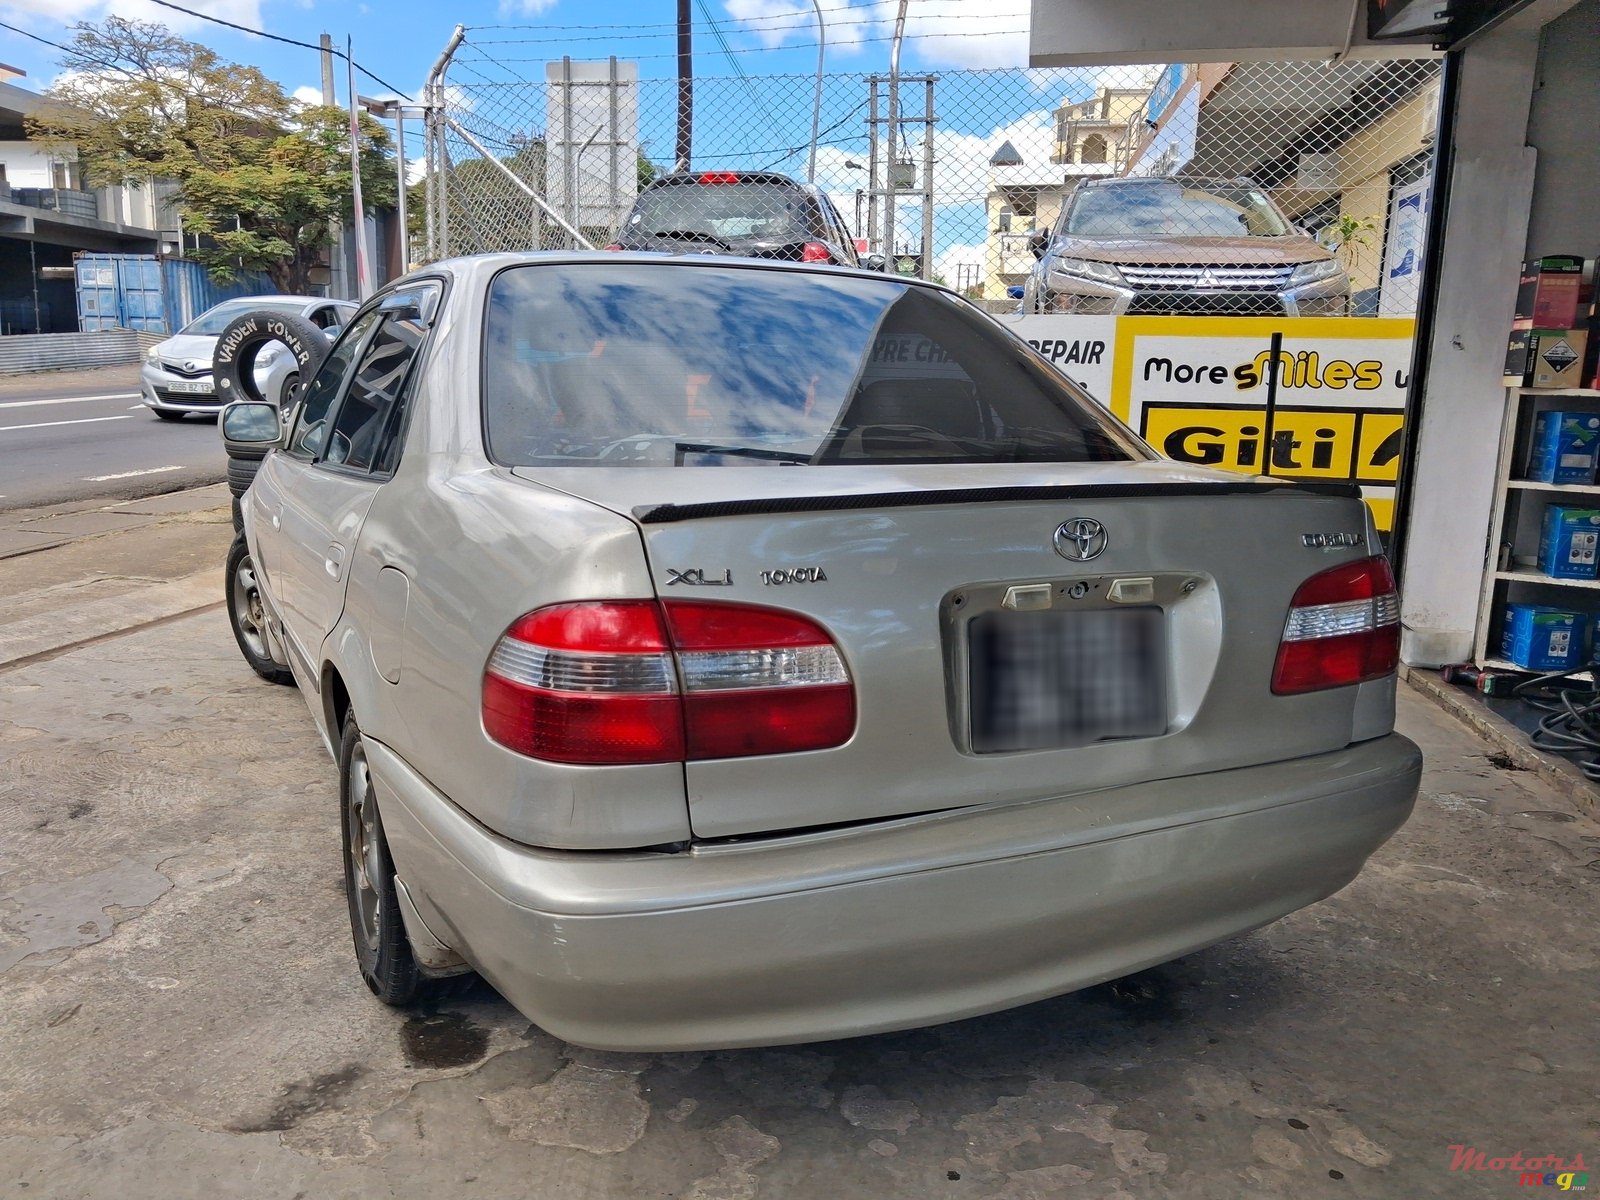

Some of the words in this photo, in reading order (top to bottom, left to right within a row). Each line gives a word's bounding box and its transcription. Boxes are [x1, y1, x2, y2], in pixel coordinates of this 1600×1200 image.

[218, 318, 258, 363] VARDEN
[267, 319, 310, 365] POWER
[1143, 357, 1228, 384] More
[1163, 425, 1337, 469] Giti
[759, 566, 828, 587] TOYOTA
